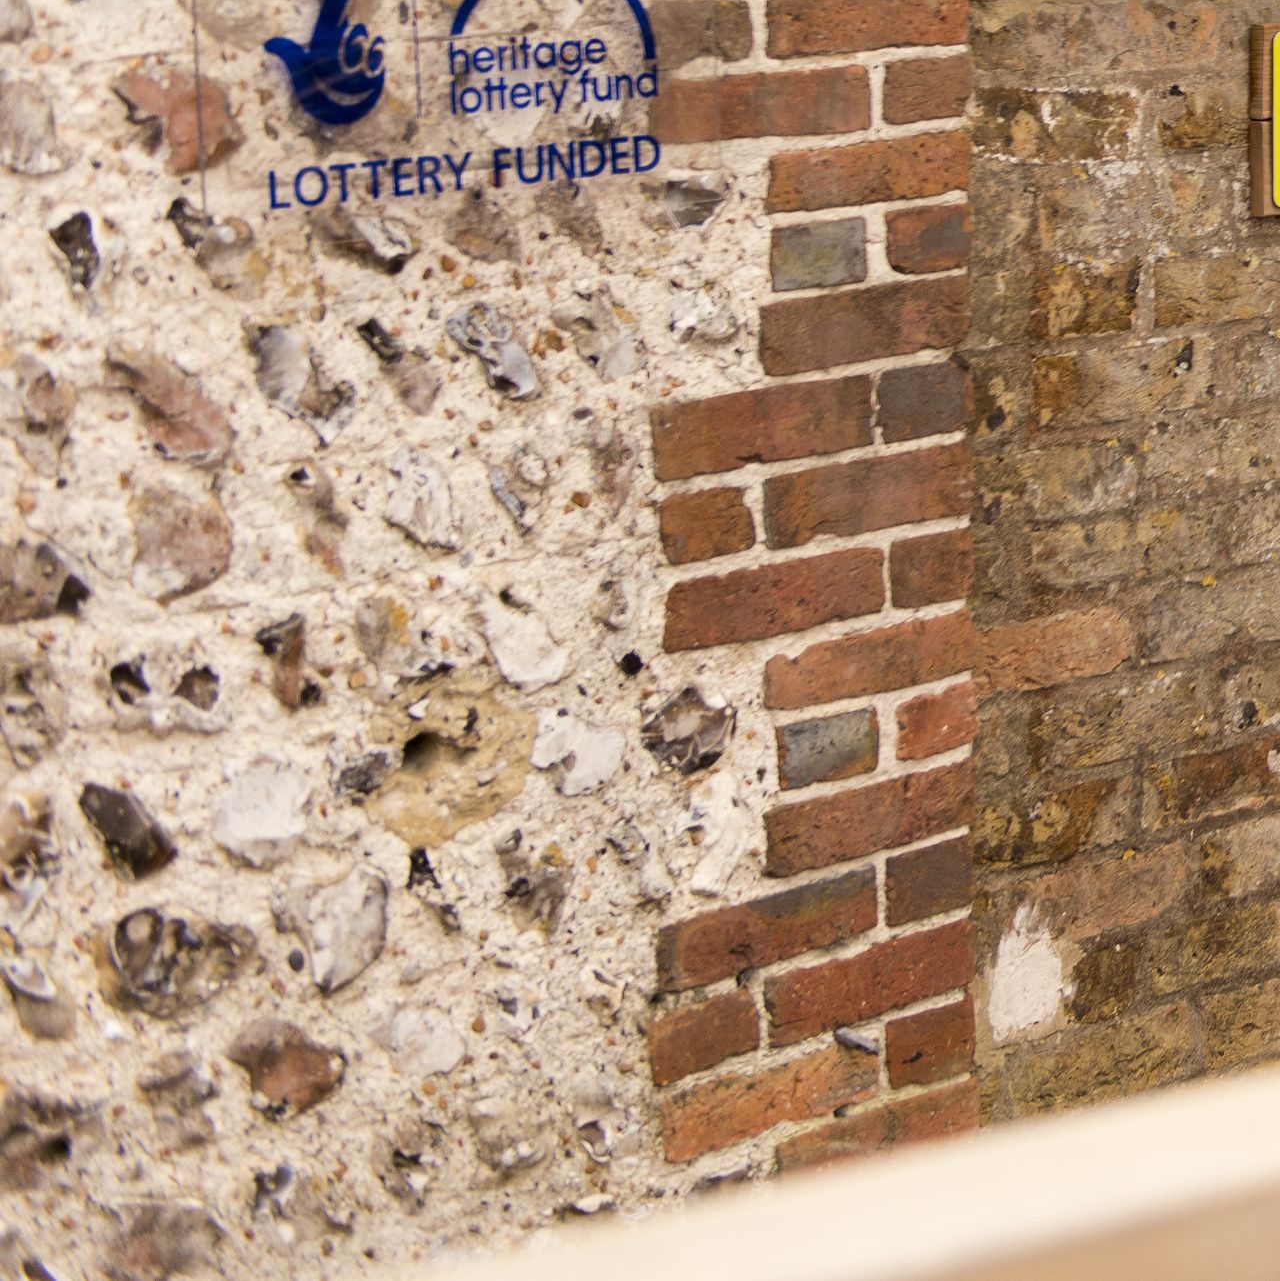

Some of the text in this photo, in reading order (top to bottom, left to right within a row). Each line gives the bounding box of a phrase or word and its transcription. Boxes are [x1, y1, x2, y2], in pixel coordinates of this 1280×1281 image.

[449, 35, 608, 75] heritage
[449, 64, 659, 115] lottery fund
[267, 135, 662, 210] LOTTERY FUNDED
